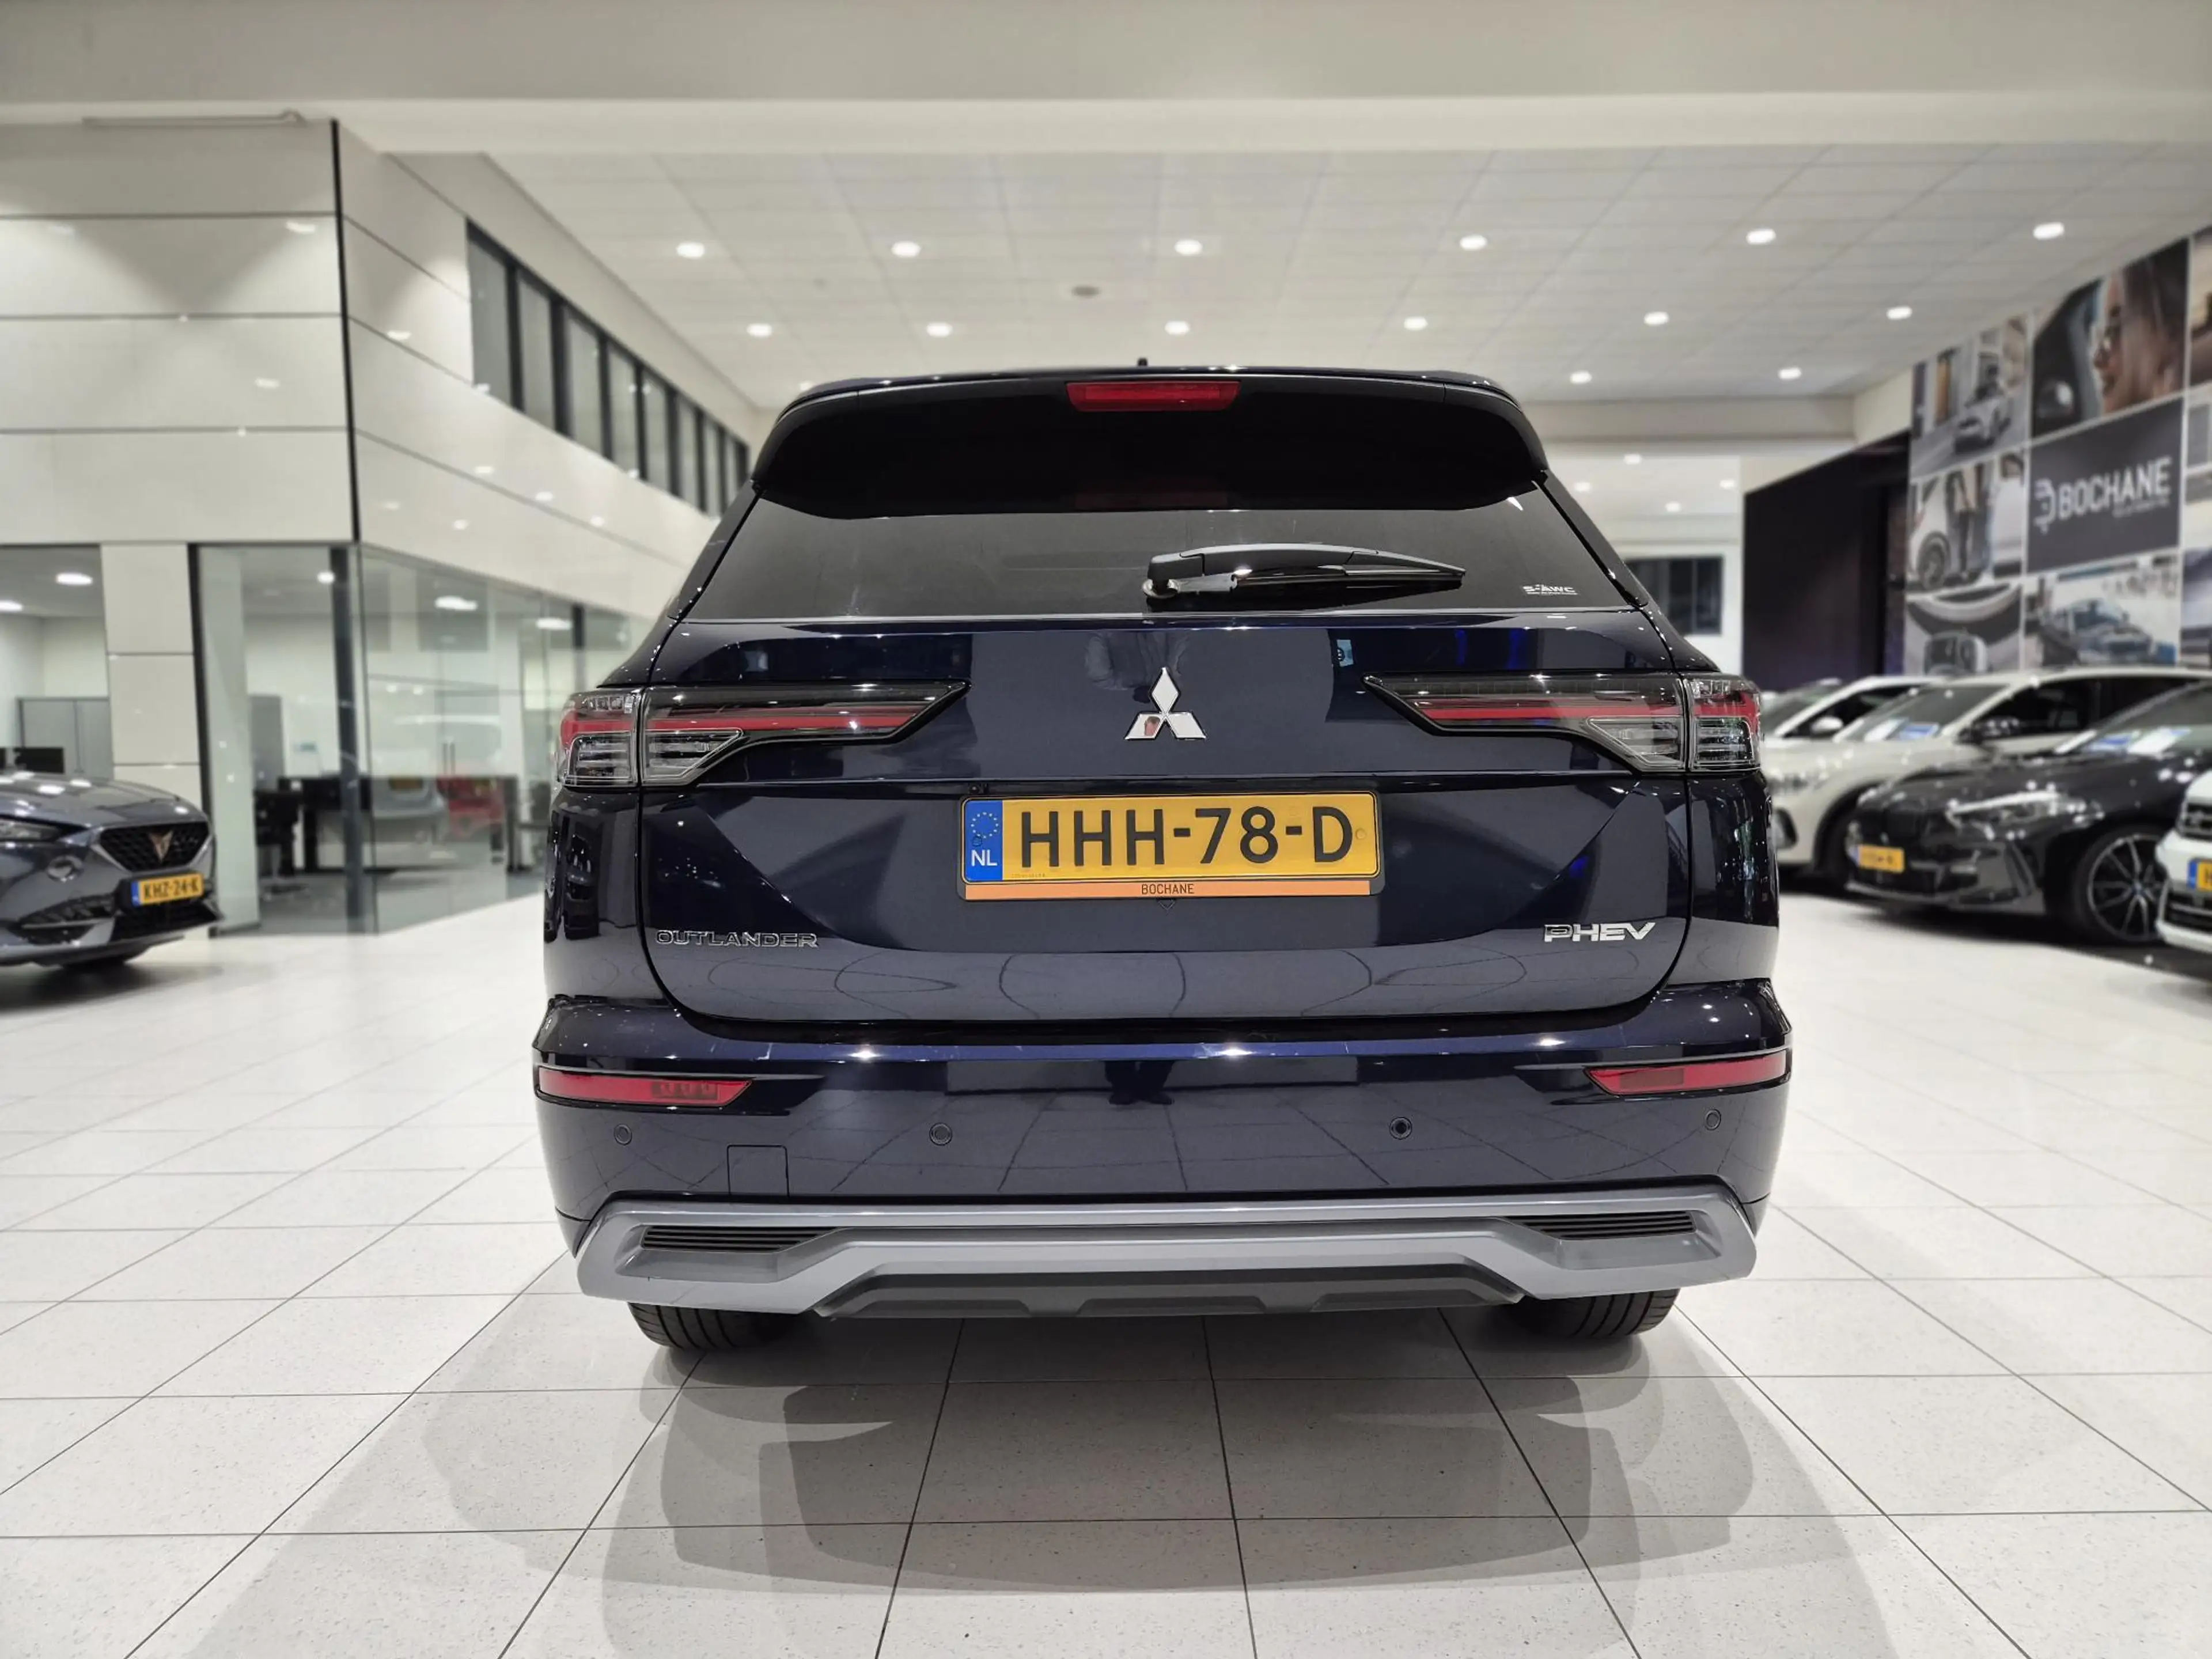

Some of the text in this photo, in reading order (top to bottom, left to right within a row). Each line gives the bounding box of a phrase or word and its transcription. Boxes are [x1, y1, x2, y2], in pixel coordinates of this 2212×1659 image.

[2058, 456, 2172, 521] BOCHANE
[1021, 806, 1353, 868] HHH-78-D
[971, 849, 998, 867] NL
[1141, 883, 1195, 895] BOCHANE
[656, 930, 819, 948] OUTLANDER
[1544, 922, 1656, 942] PHEV
